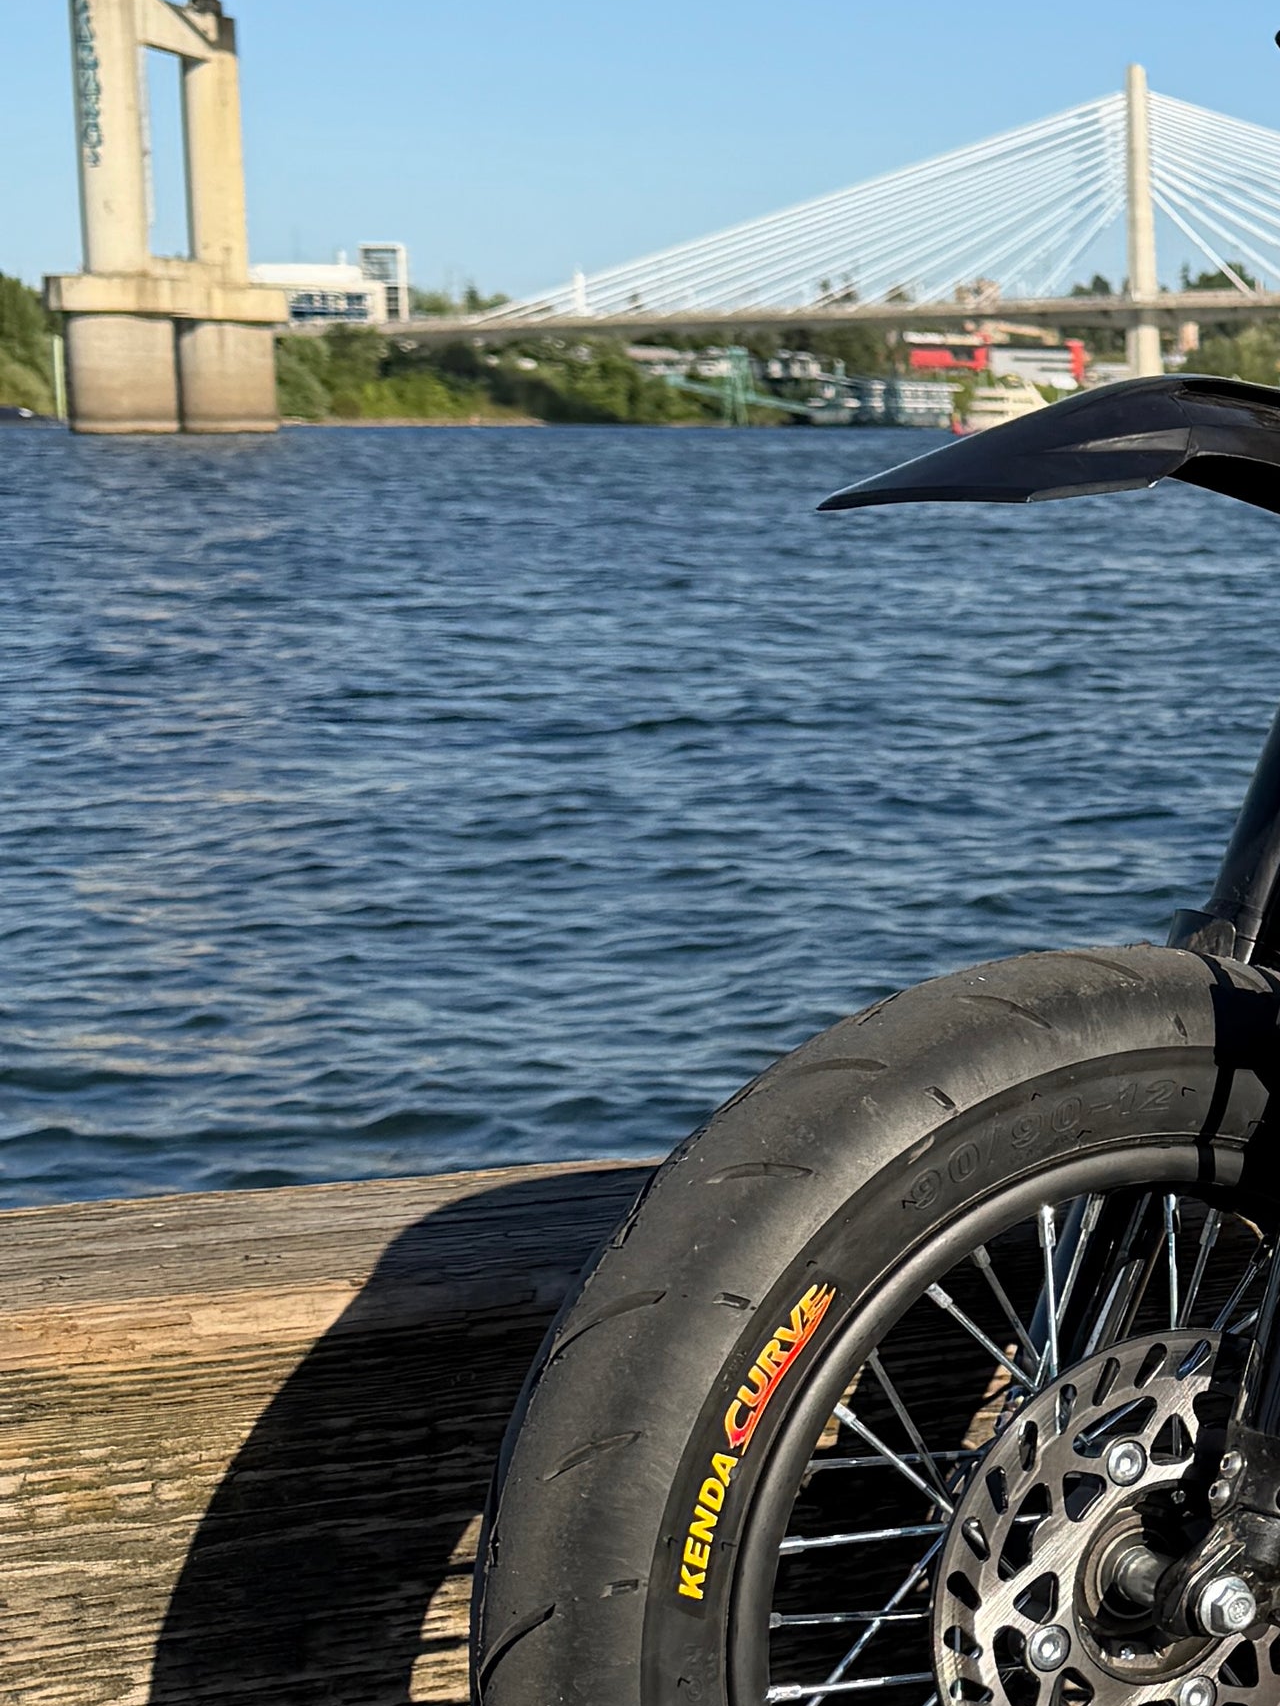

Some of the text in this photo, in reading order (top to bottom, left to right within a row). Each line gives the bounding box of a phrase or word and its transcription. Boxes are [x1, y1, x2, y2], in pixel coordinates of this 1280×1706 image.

[909, 1080, 1178, 1211] 90/90-12
[678, 1283, 838, 1601] KENDA CURVE
